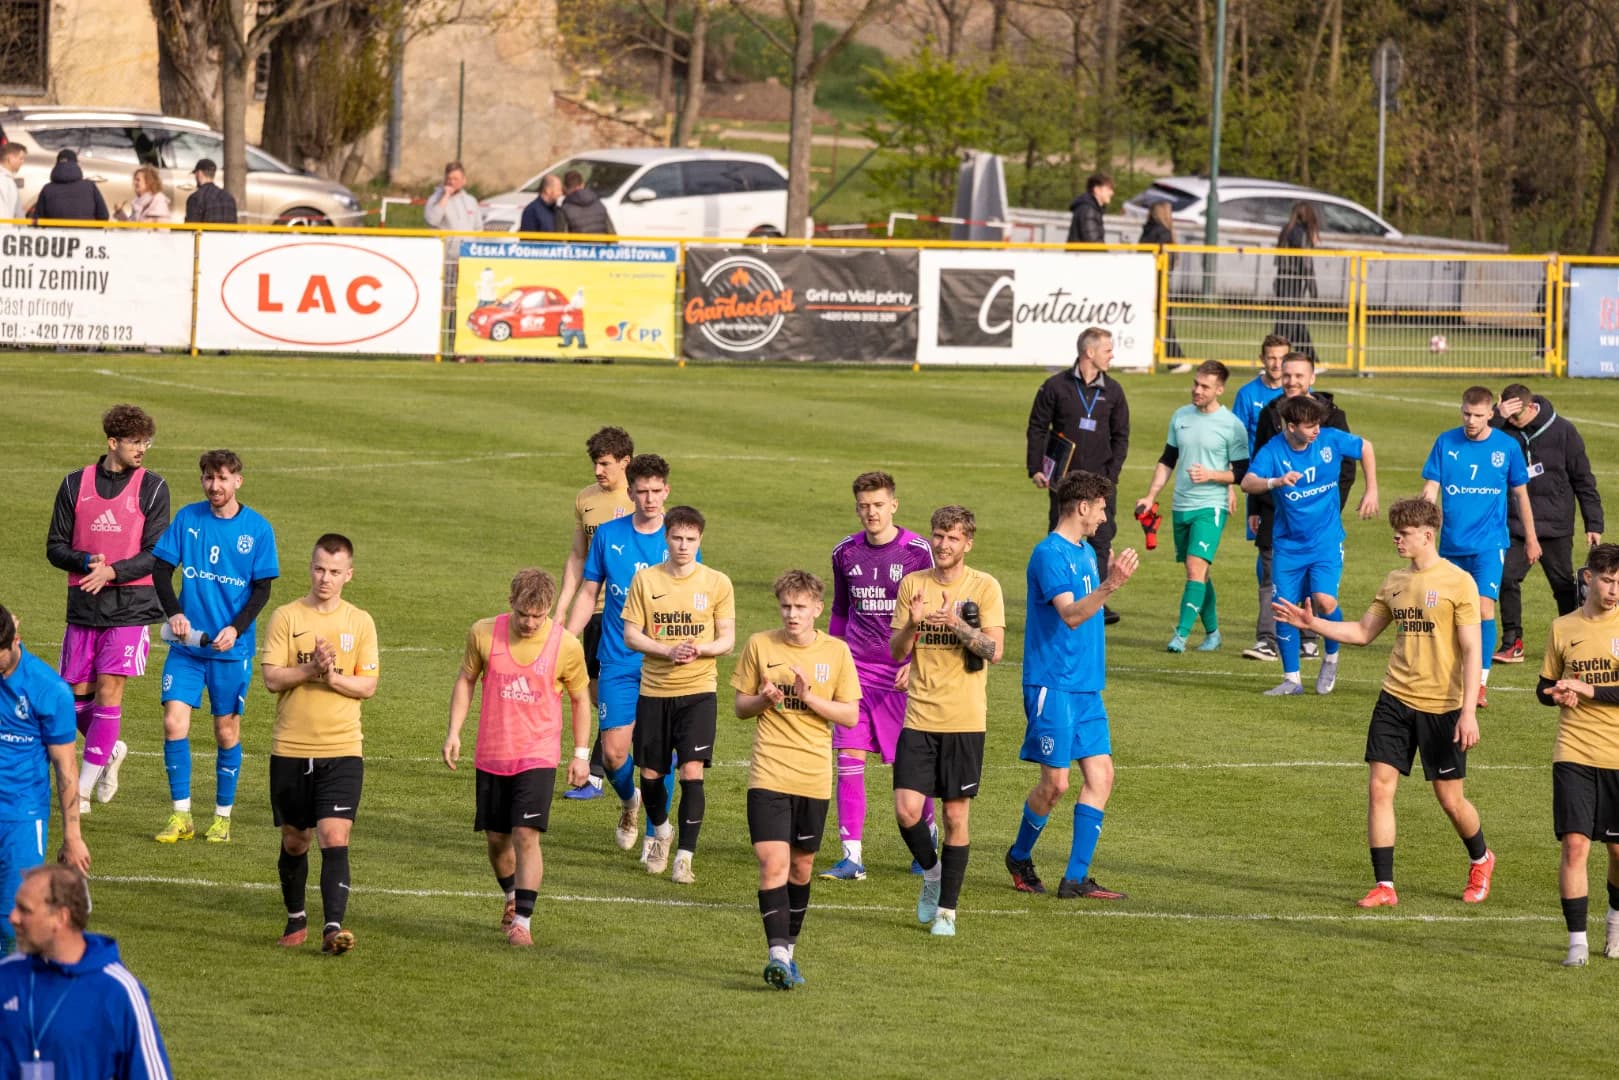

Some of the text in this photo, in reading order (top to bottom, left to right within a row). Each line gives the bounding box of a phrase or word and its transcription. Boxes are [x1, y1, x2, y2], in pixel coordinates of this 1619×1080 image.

[3, 235, 110, 259] GROUP a.s.
[470, 243, 505, 257] ČESKÁ
[509, 244, 597, 259] PODNIKATELSKÁ
[2, 264, 109, 295] dní zeminy
[258, 273, 383, 315] LAC
[806, 288, 829, 302] Gril
[830, 292, 847, 302] na
[28, 298, 73, 320] přírody
[978, 275, 1135, 335] Container
[30, 324, 58, 340] +420
[88, 324, 110, 341] 726
[113, 325, 133, 341] 123
[1304, 466, 1315, 483] 17
[1470, 464, 1478, 480] 7
[209, 545, 220, 565] 8
[199, 570, 246, 588] brandmix
[872, 567, 878, 580] 1
[1082, 574, 1092, 595] 11
[653, 610, 692, 624] ŠEVČÍK
[667, 624, 705, 636] GROUP
[1403, 620, 1436, 633] GROUP
[1572, 657, 1611, 672] ŠEVČÍK
